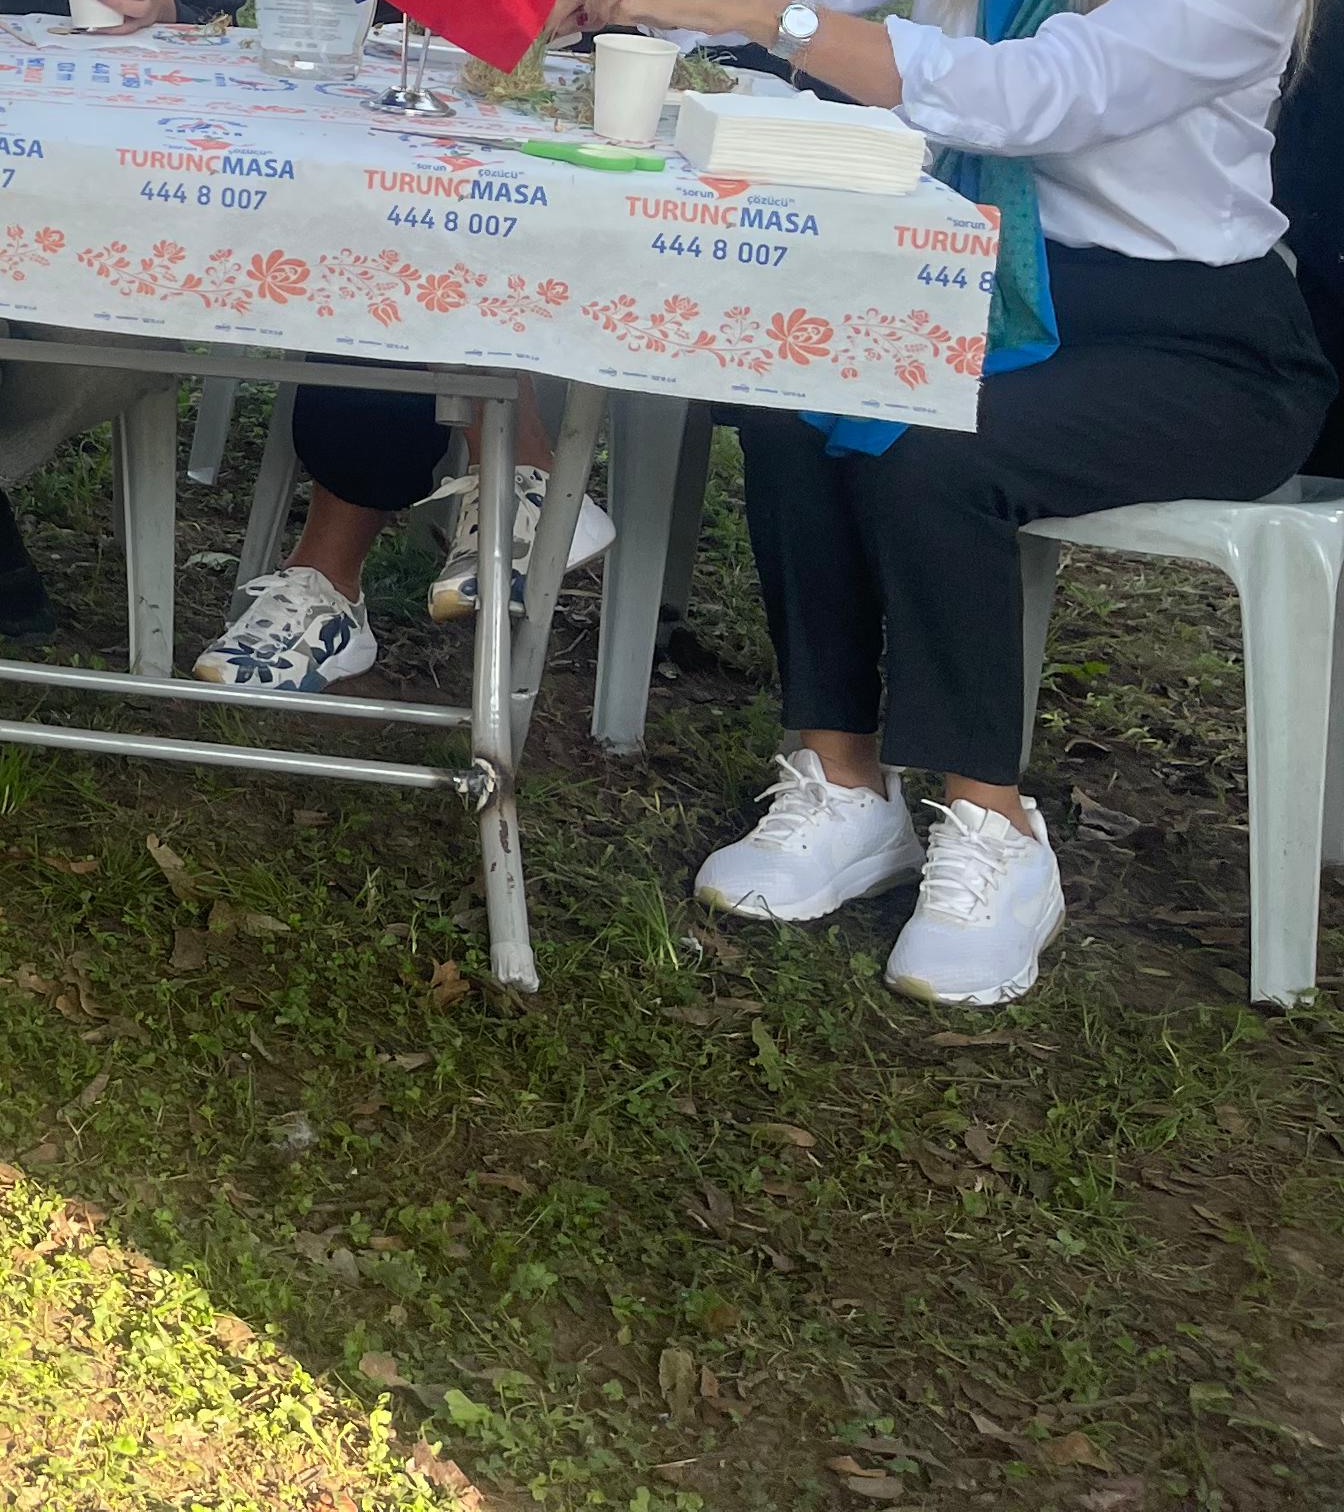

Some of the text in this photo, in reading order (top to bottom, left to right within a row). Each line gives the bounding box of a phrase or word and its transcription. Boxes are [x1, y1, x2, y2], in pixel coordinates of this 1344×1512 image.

[116, 148, 295, 180] TURUNÇMASA
[140, 180, 268, 211] 444 8 007
[363, 169, 549, 207] TURUNÇMASA
[676, 187, 715, 199] "sorun
[387, 205, 518, 238] 444 8 007
[625, 195, 820, 237] TURUNÇMASA
[651, 233, 789, 267] 444 8 007
[916, 263, 996, 295] 444 8
